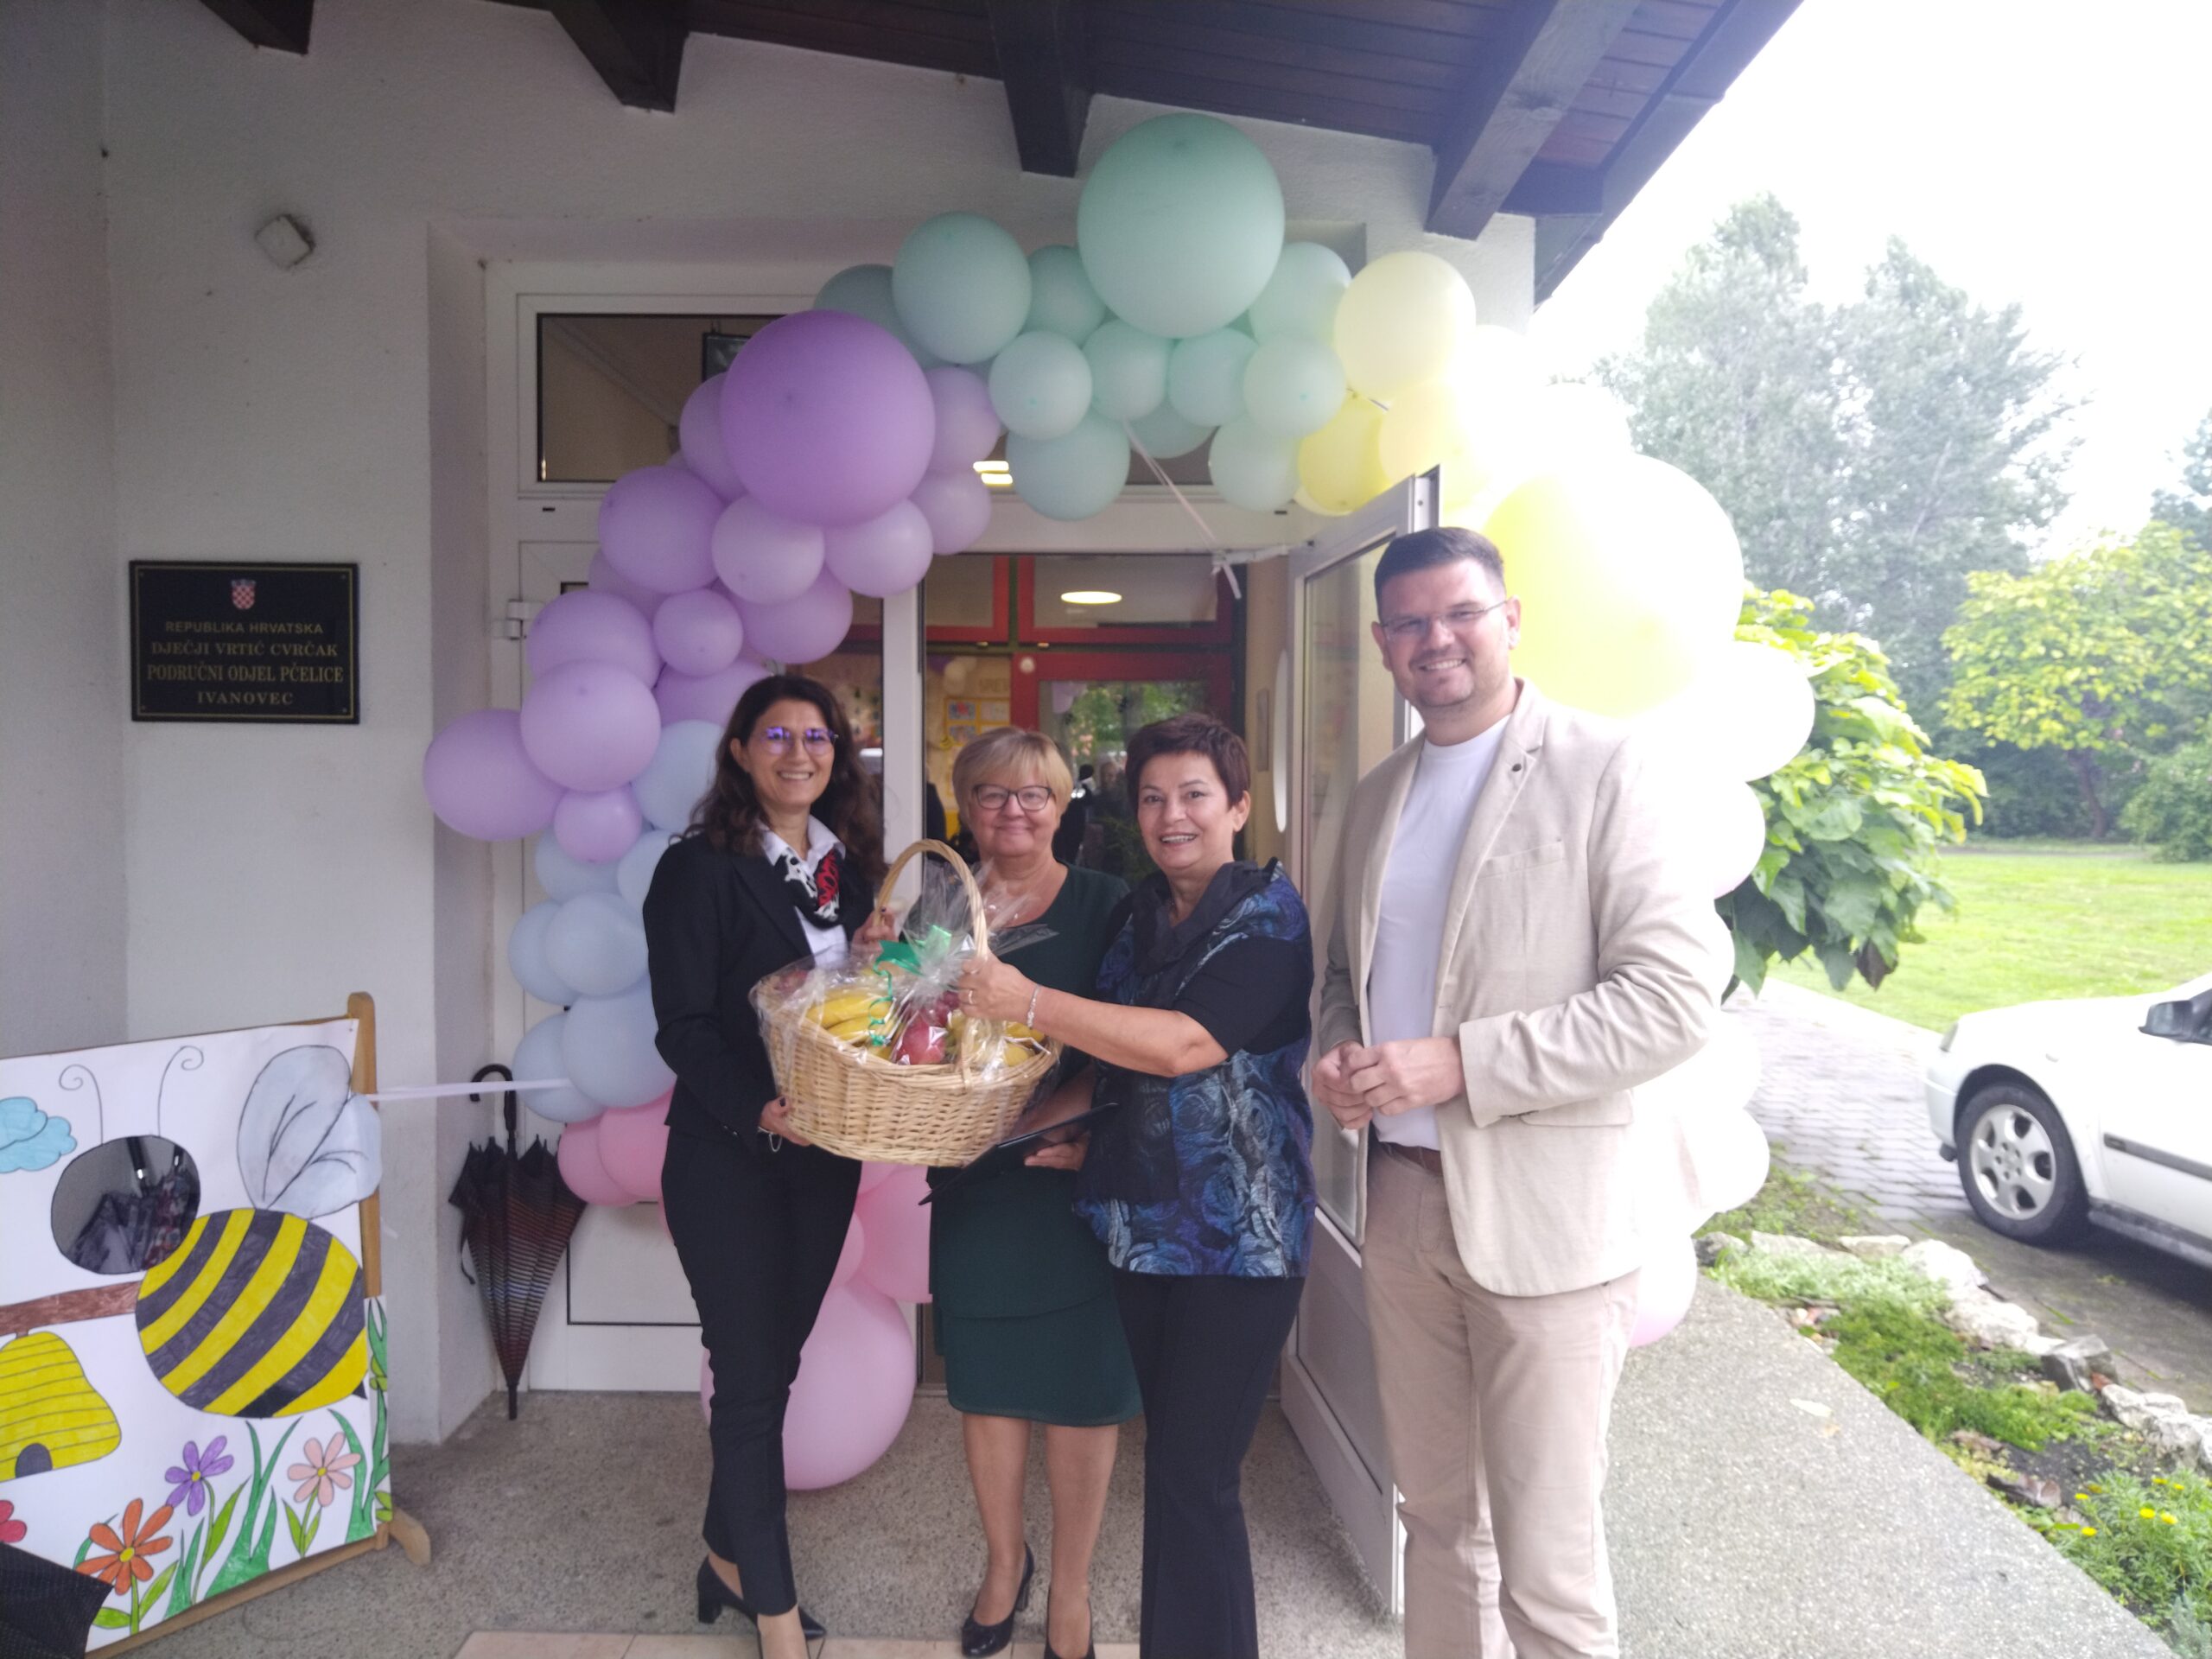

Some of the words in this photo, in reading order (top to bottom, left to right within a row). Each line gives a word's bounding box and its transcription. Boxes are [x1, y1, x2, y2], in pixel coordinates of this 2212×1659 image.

[165, 620, 245, 633] REPUBLIKA
[250, 621, 324, 634] HRVATSKA
[215, 639, 264, 656] VRTIĆ
[270, 640, 338, 657] CVRČAK
[147, 660, 223, 682] PODRUČNI
[228, 664, 276, 683] ODJEL
[280, 661, 344, 683] PČELICE
[197, 690, 294, 706] IVANOVEC
